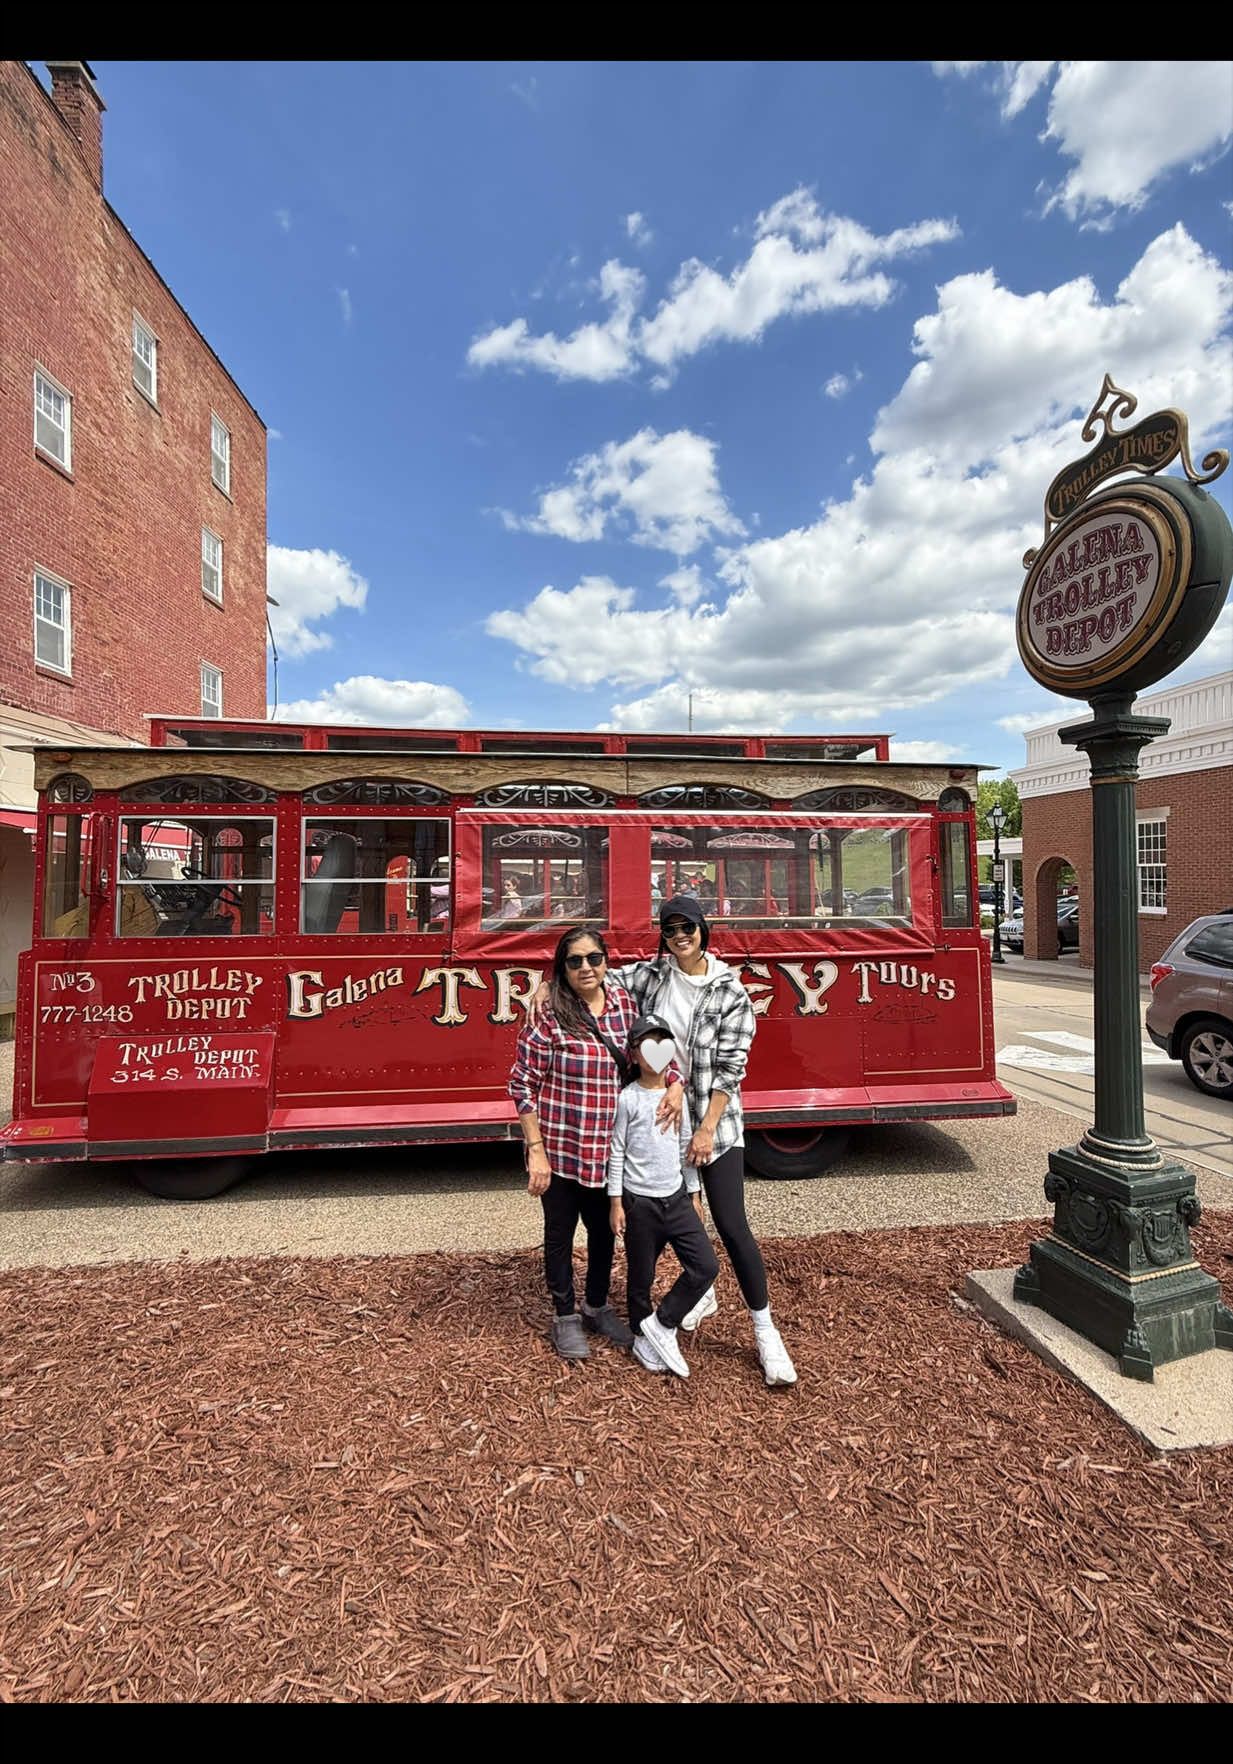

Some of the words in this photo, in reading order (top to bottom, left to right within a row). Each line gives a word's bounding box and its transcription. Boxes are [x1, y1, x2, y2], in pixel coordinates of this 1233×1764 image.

[1118, 429, 1176, 464] TIMES
[1037, 522, 1145, 597] GALENA
[1032, 552, 1154, 625] TROLLEY
[1045, 591, 1138, 657] DEPOT
[127, 966, 264, 1004] TROLLEY
[286, 967, 404, 1020] Galena
[40, 1004, 134, 1024] 777-1248
[166, 997, 252, 1020] DEPOT
[118, 1036, 213, 1066] TROLLEY
[193, 1049, 260, 1065] DEPOT
[110, 1069, 157, 1083] 314
[160, 1067, 184, 1081] S.
